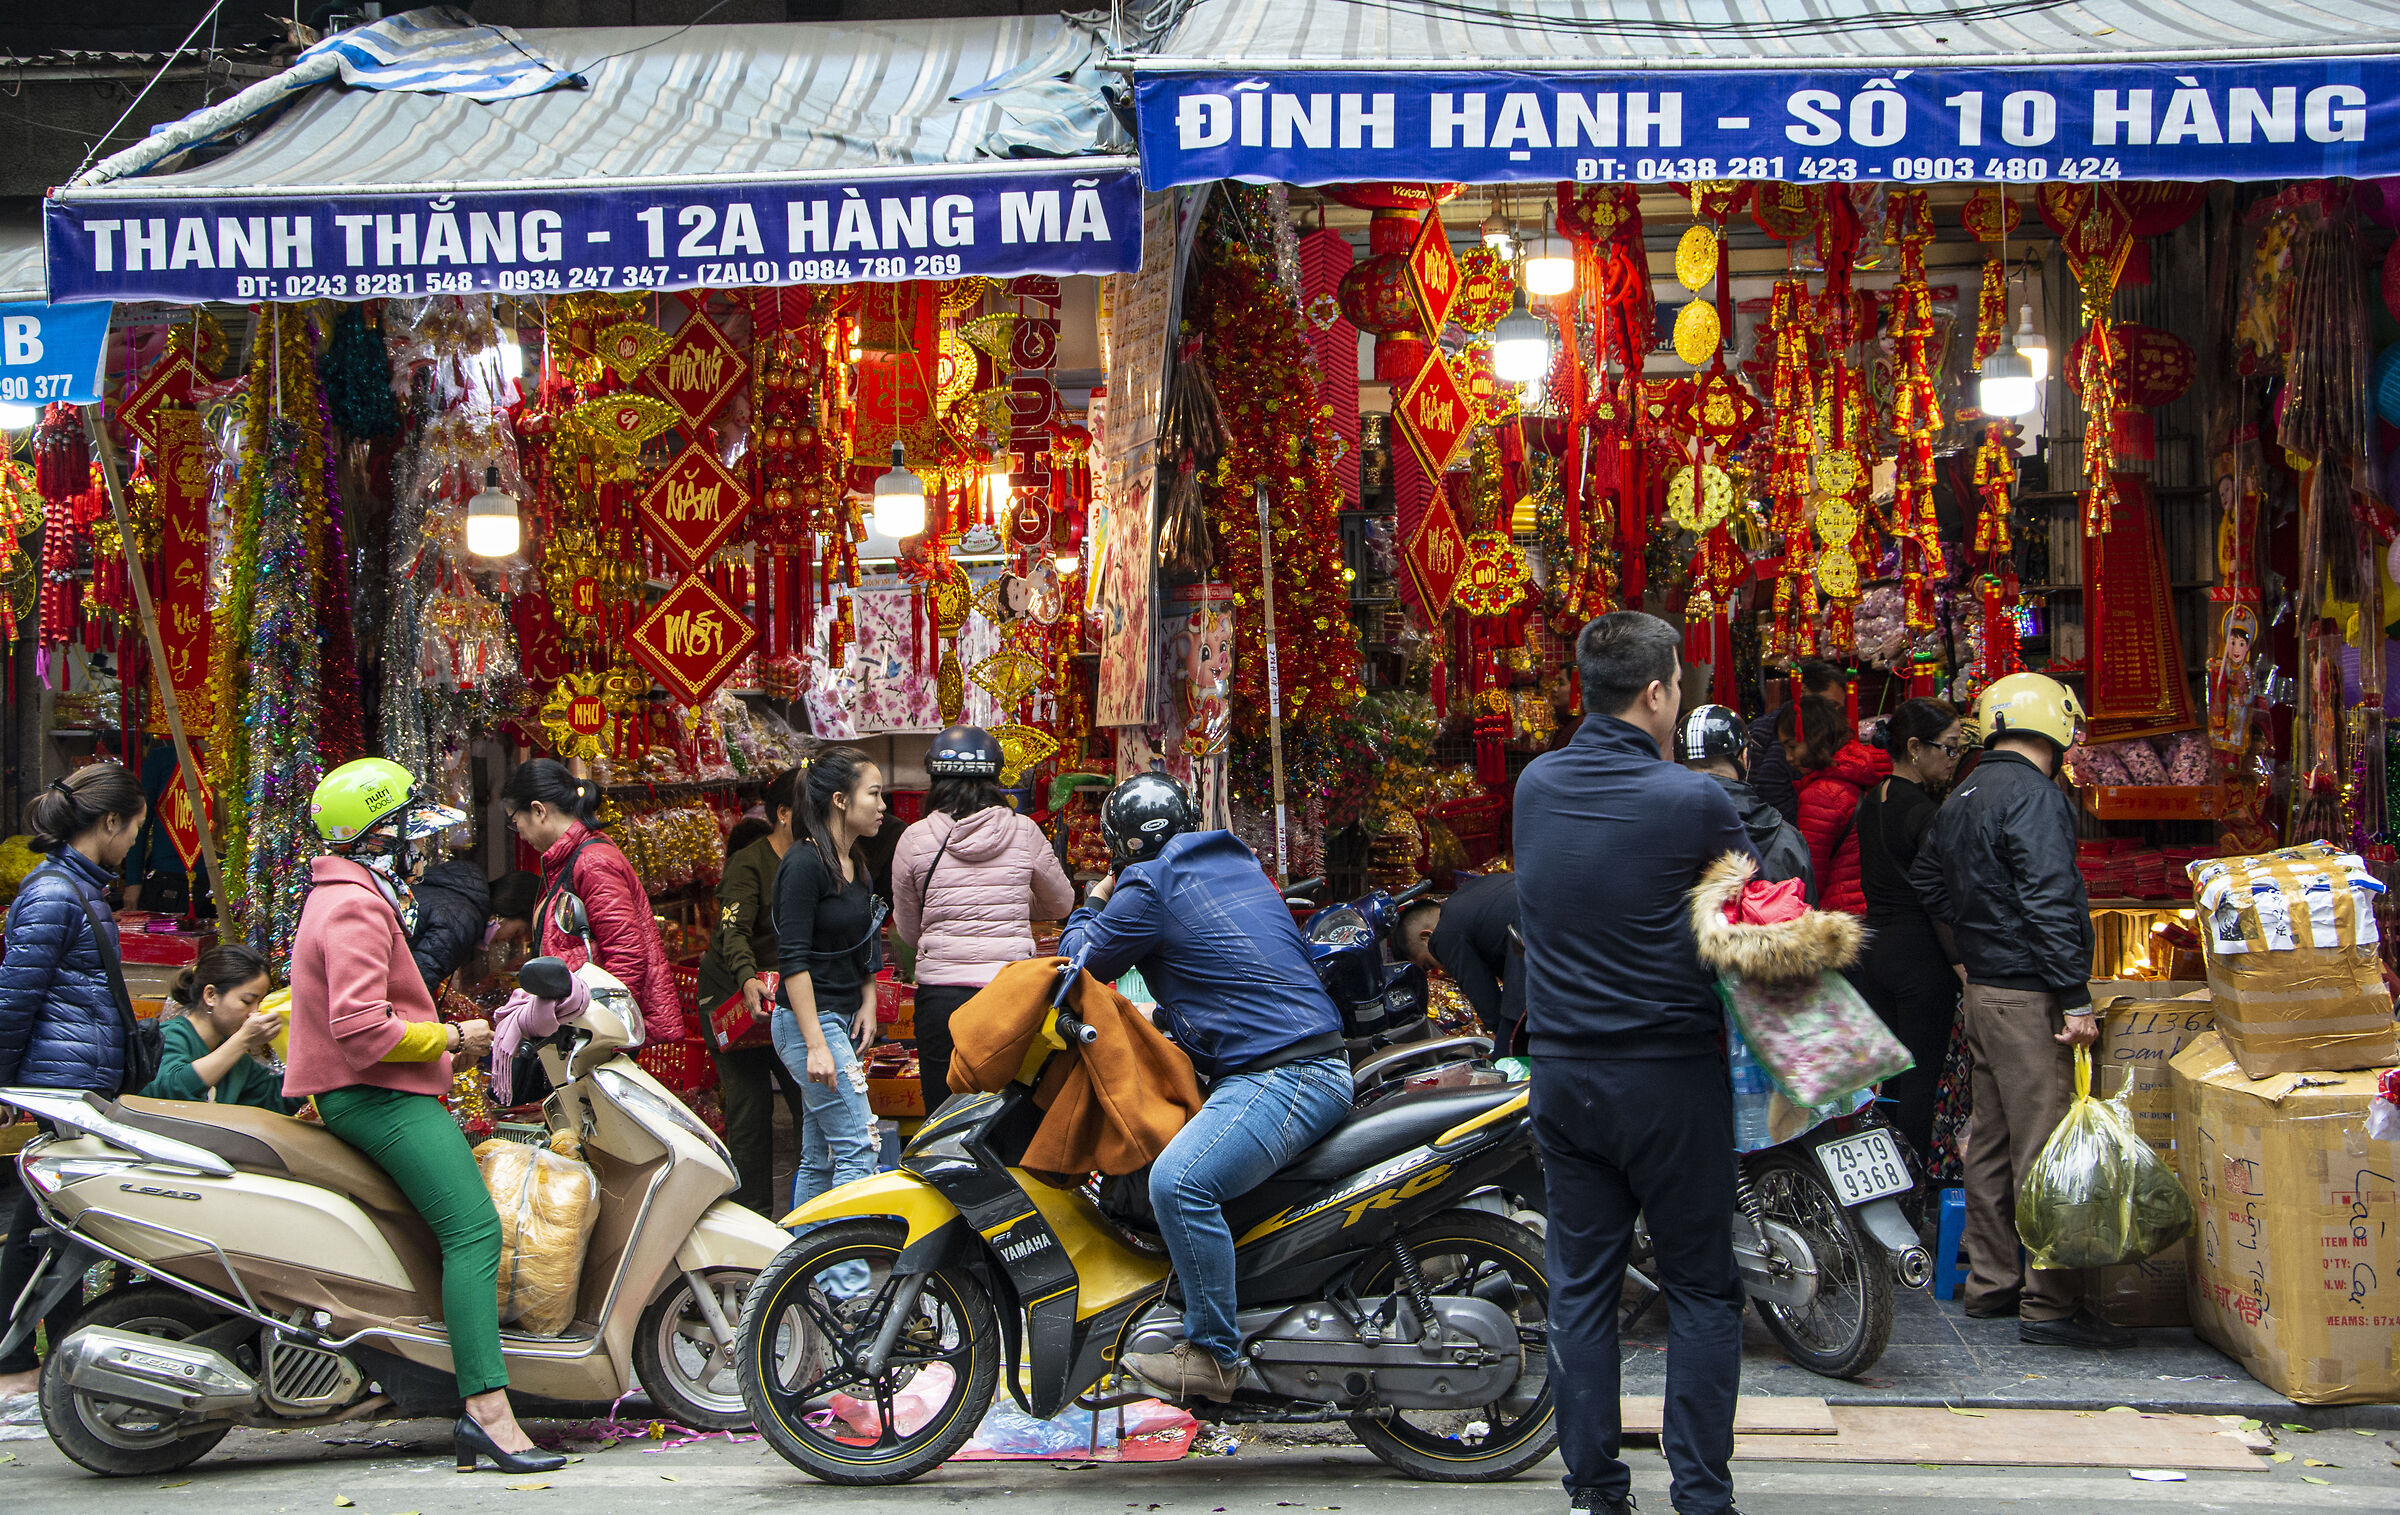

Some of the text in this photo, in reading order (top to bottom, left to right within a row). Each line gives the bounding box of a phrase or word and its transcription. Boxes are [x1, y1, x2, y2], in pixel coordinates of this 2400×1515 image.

[1174, 80, 1395, 150] ĐĨNH
[1430, 92, 1683, 161] HẠNH
[1785, 69, 1915, 147] SỐ
[1945, 90, 2057, 147] 10
[2092, 76, 2367, 146] HÀNG
[1575, 158, 1626, 181] ĐT:
[1636, 157, 1717, 180] 0438
[1727, 156, 1784, 179] 281
[1798, 156, 1858, 180] 423
[1891, 157, 1974, 180] 0903
[1985, 157, 2048, 180] 480
[2057, 157, 2122, 180] 424
[83, 215, 313, 272] THANH
[334, 194, 562, 267] THẮNG
[636, 202, 765, 258] 12A
[787, 187, 975, 254] HÀNG
[999, 178, 1112, 244] MÃ
[236, 275, 278, 297] ĐT:
[285, 274, 348, 296] 0243
[355, 273, 416, 295] 8281
[425, 272, 473, 293] 548
[499, 269, 562, 291] 0934
[568, 266, 614, 289] 247
[622, 265, 670, 287] 347
[697, 259, 780, 287] (ZALO)
[788, 259, 852, 281] 0984
[858, 257, 907, 279] 780
[914, 253, 961, 276] 269
[1467, 280, 1493, 300] CHÚC
[0, 315, 44, 366] B
[668, 341, 724, 394] MỪNG
[0, 373, 73, 401] 90 377
[1419, 384, 1455, 434] NĂM
[664, 467, 722, 523] NĂM
[1475, 568, 1496, 584] MỚI
[364, 784, 391, 807] nutri
[1830, 1136, 1889, 1173] 29-T9
[118, 1182, 202, 1202] LEAD
[1843, 1162, 1900, 1198] 9368
[999, 1232, 1052, 1264] YAMAHA
[2320, 1236, 2348, 1248] ITEM
[135, 1355, 182, 1372] LEAD
